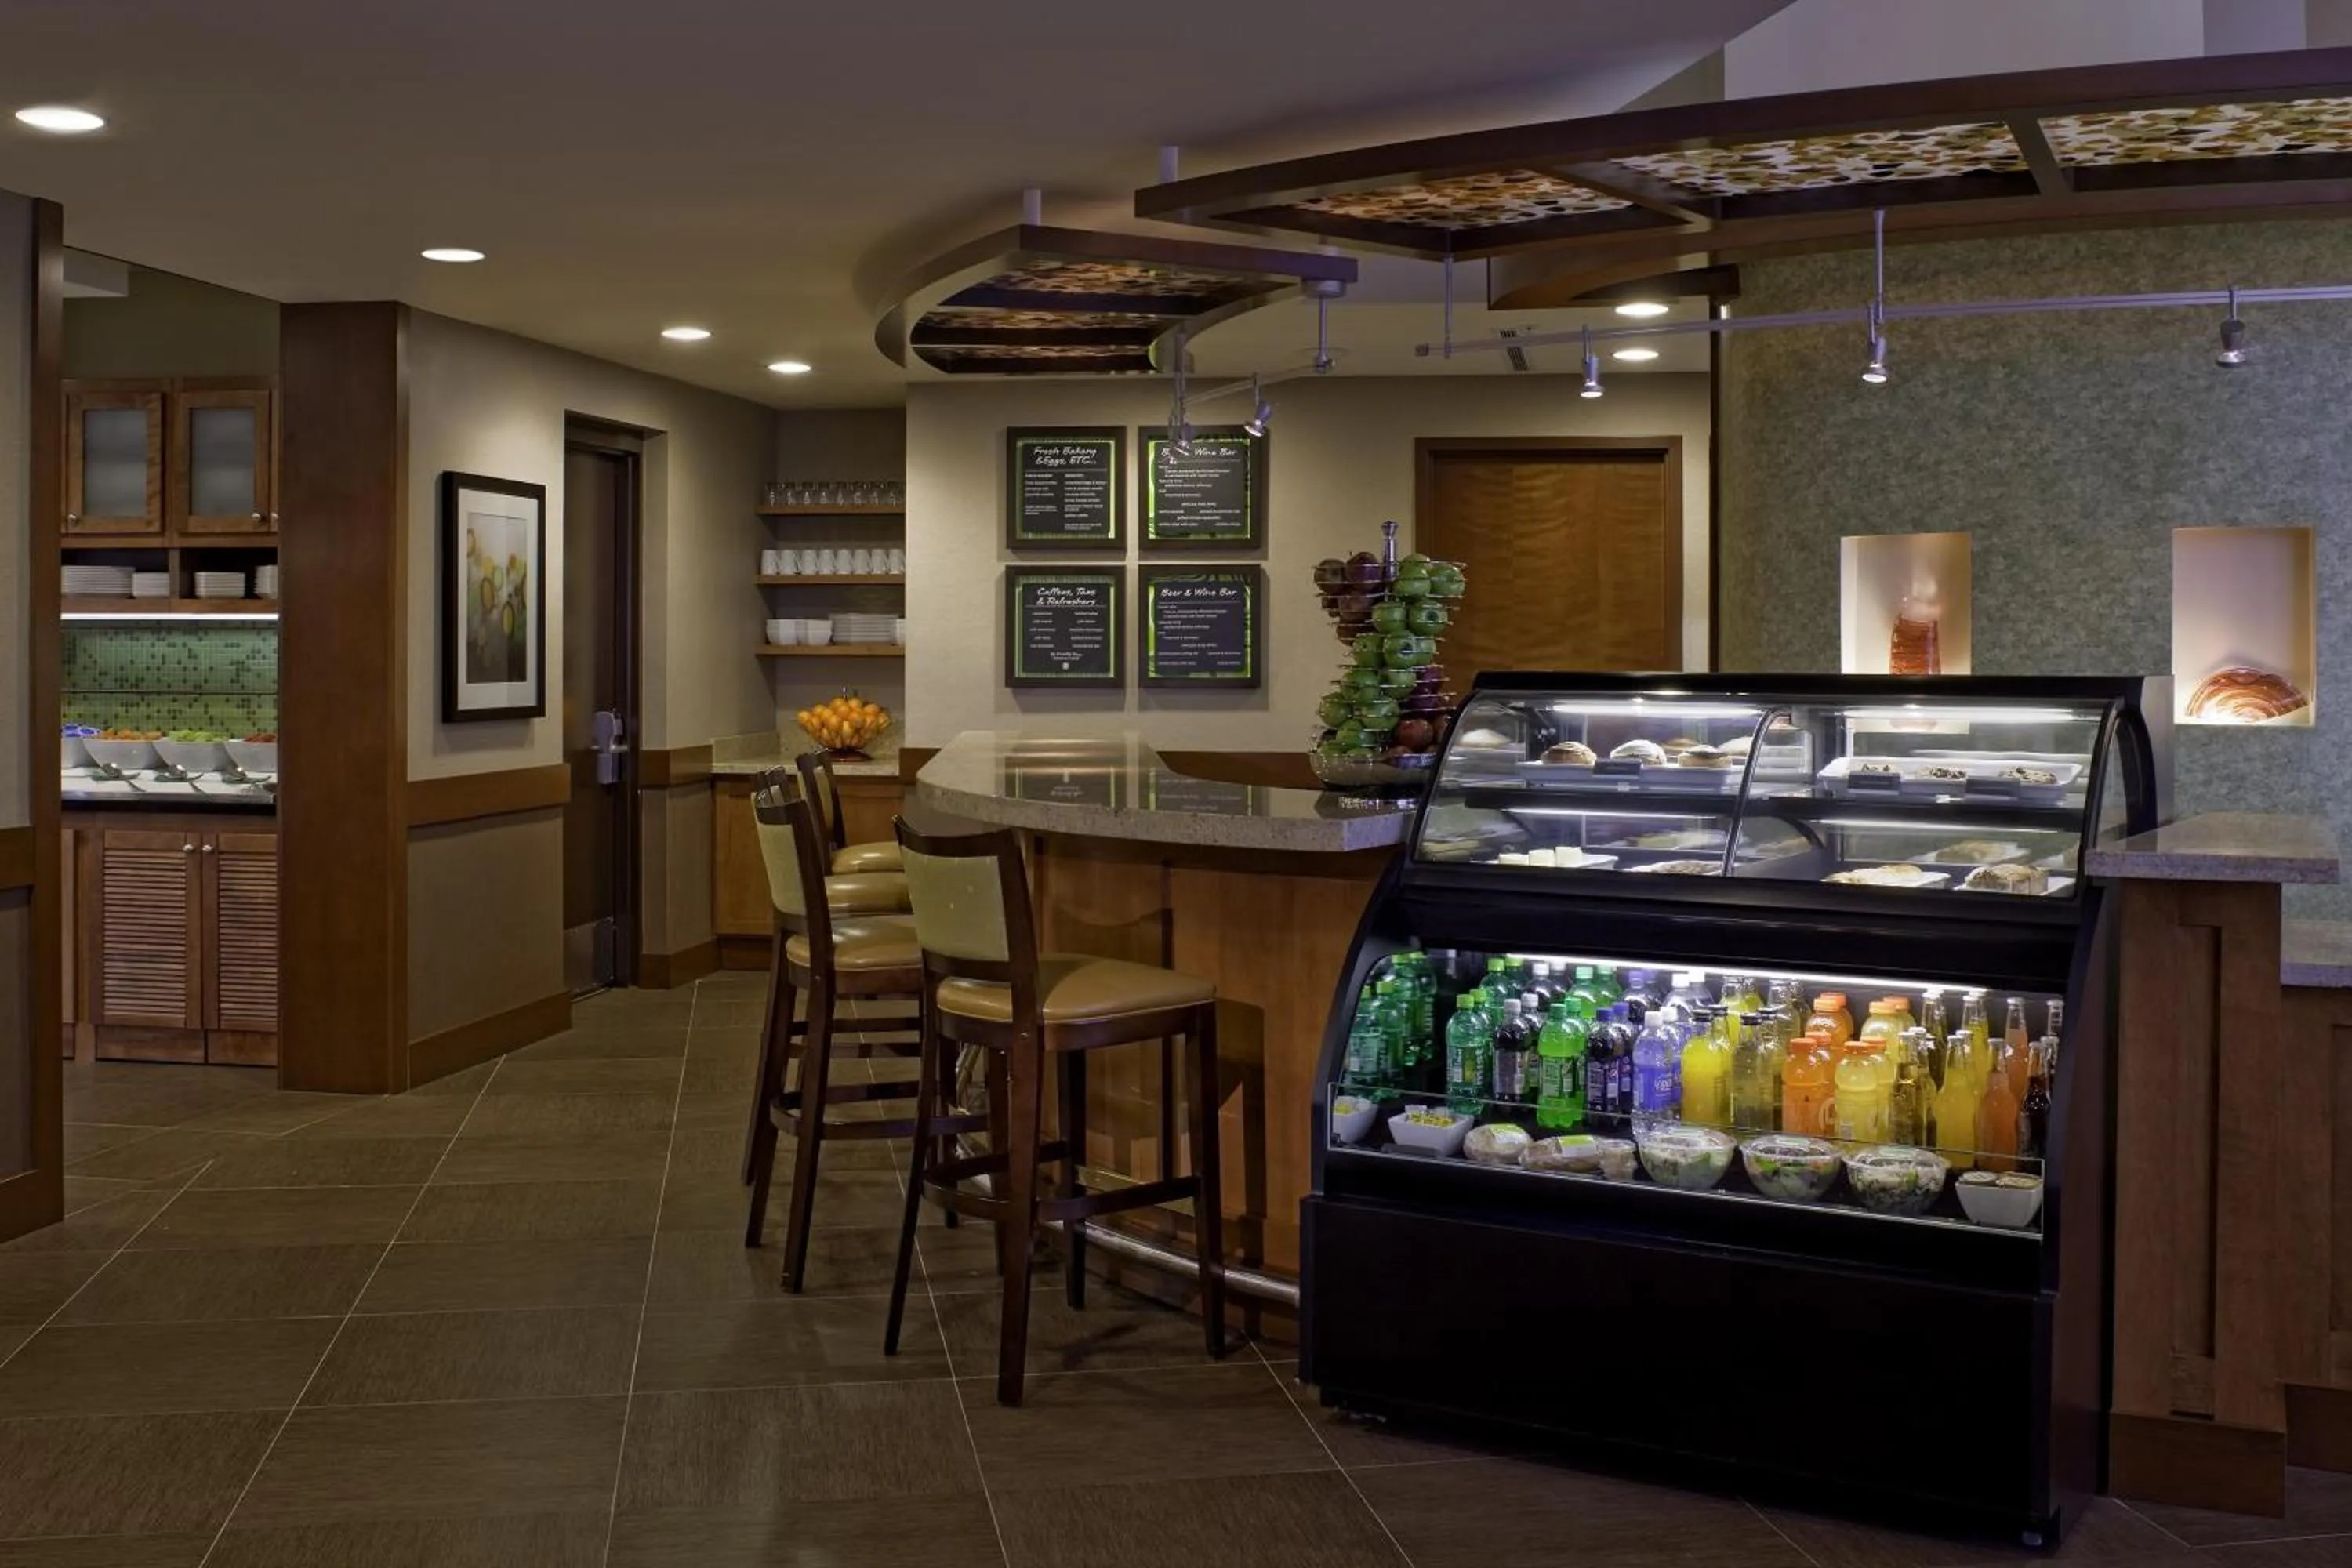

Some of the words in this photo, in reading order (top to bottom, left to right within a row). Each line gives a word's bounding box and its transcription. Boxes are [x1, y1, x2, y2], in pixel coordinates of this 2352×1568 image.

[1034, 446, 1059, 455] Fresh
[1062, 446, 1097, 458] Bakery
[1076, 587, 1097, 596] Teas
[1161, 588, 1183, 597] Beer
[1194, 587, 1216, 596] Wine
[1219, 587, 1238, 596] Bar
[1047, 597, 1095, 606] Refreshers
